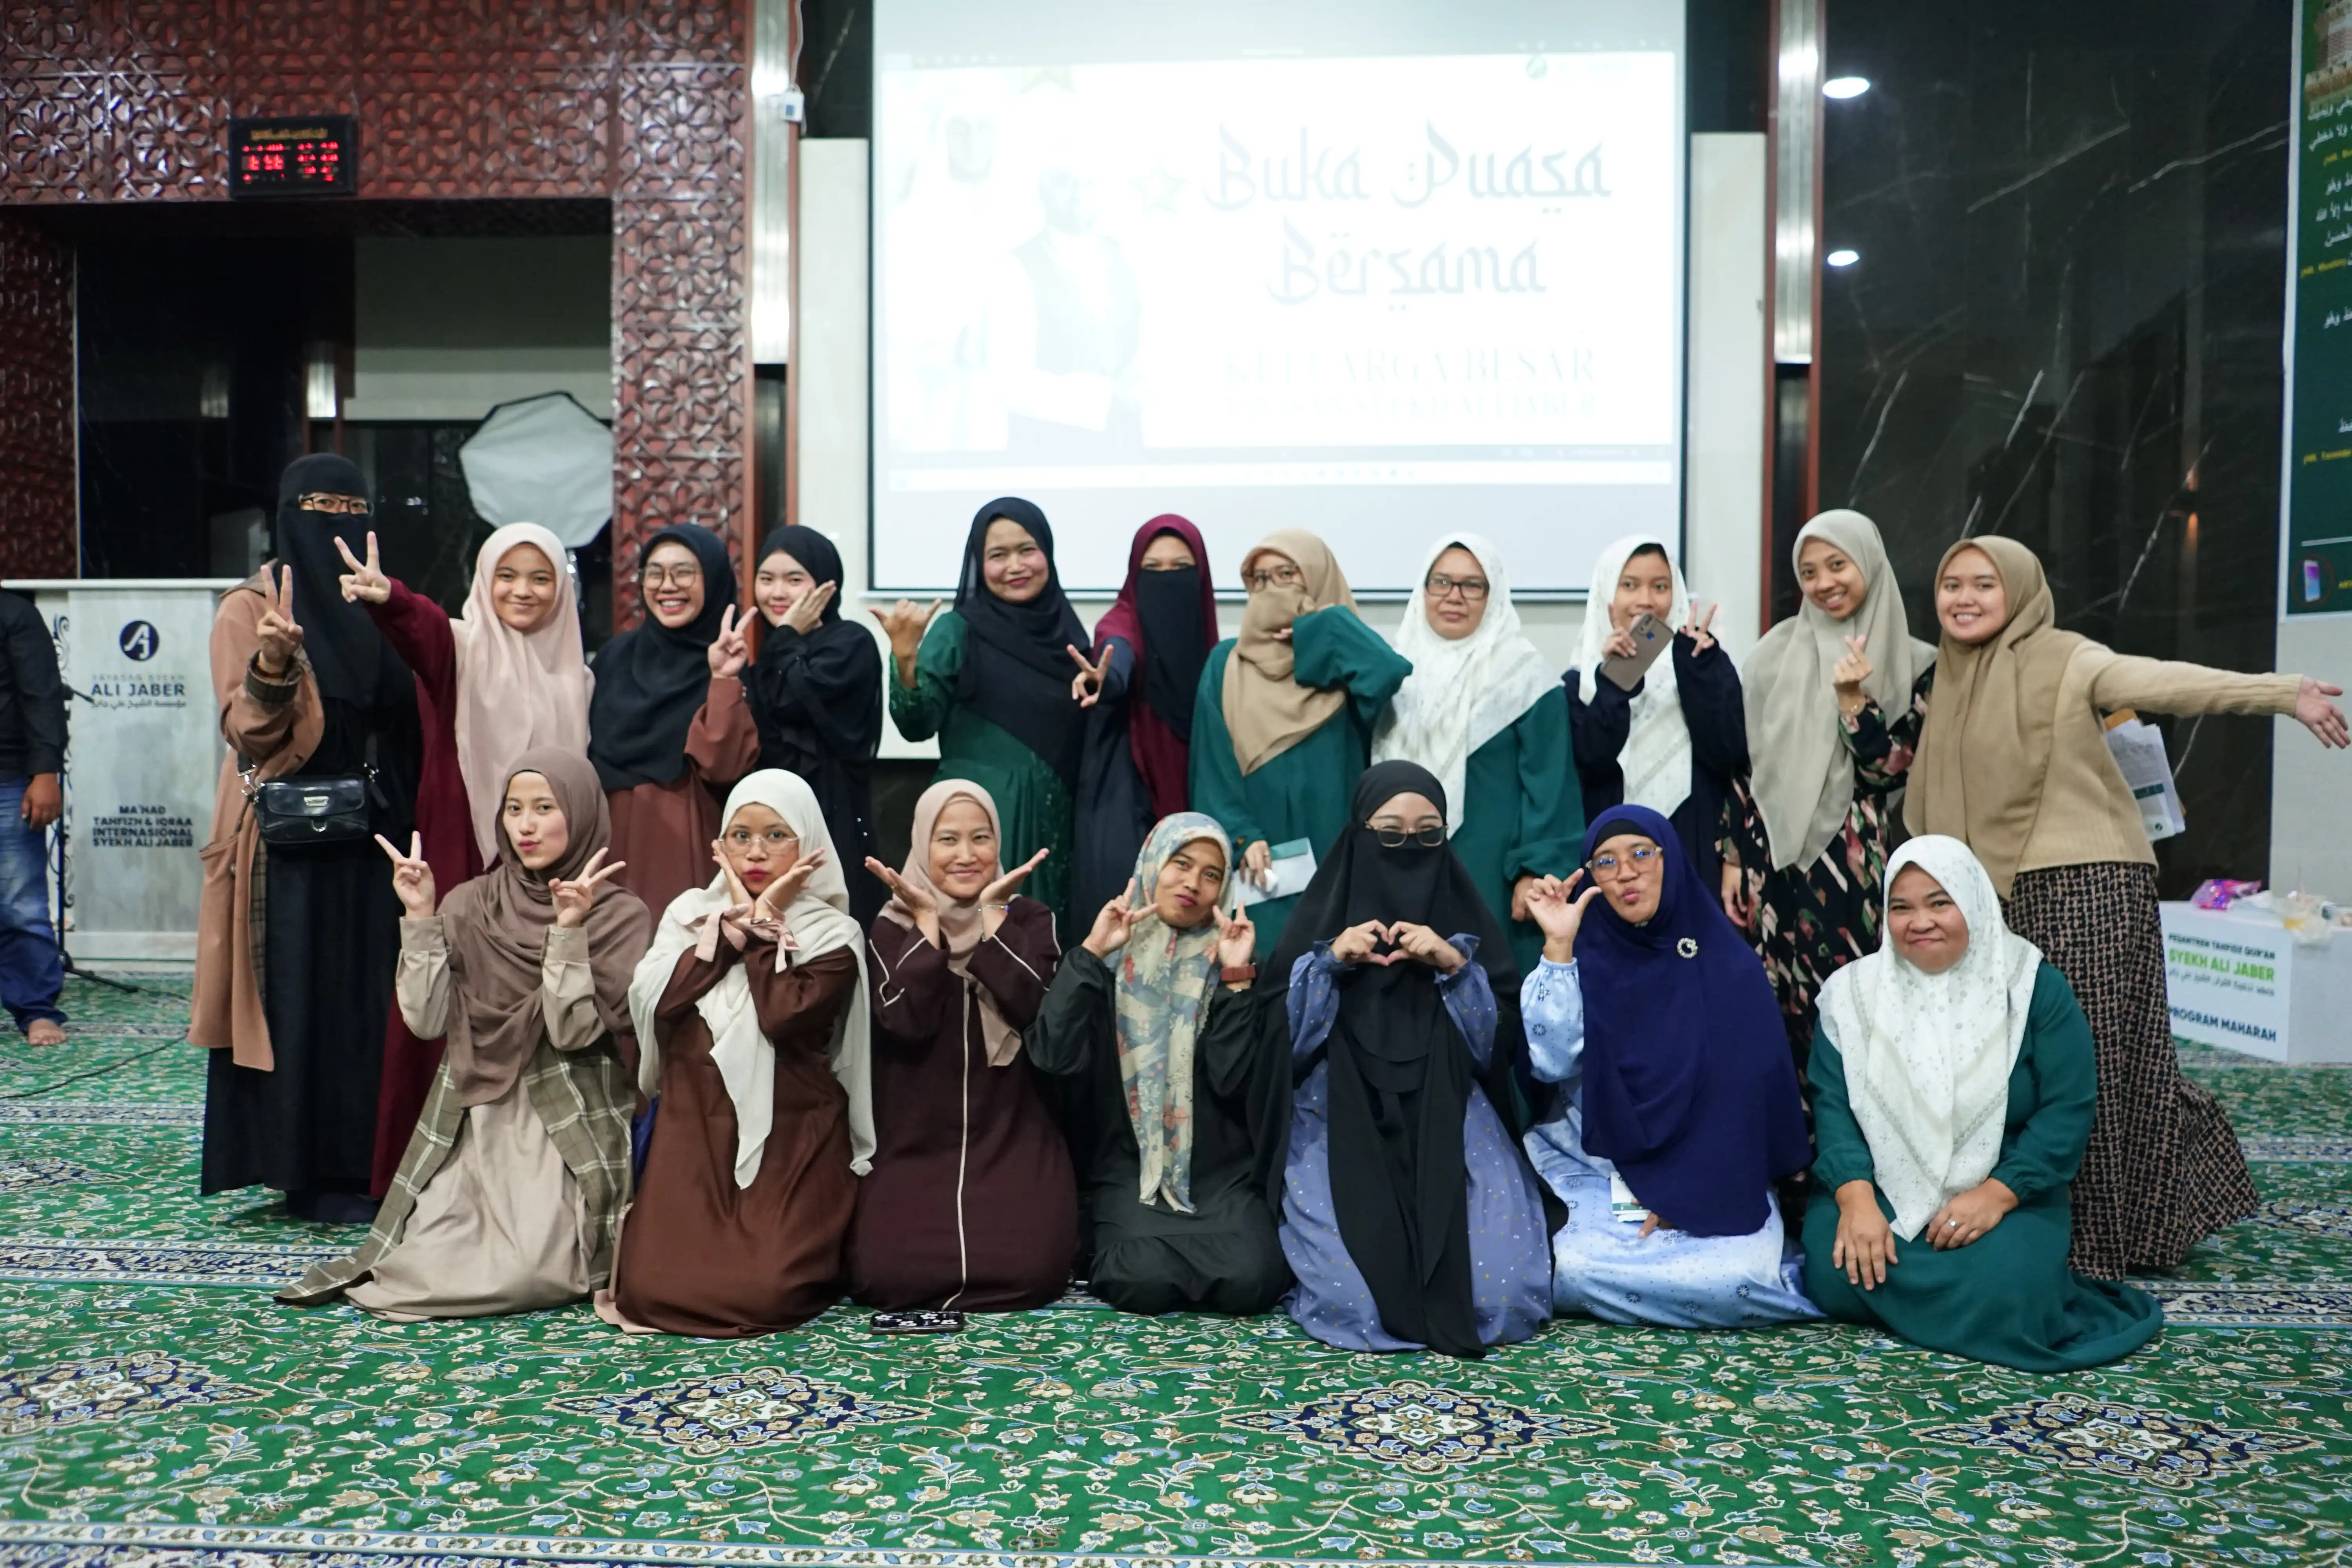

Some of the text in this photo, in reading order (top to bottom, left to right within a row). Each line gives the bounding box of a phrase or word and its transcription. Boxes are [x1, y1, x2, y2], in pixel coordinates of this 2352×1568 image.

[1202, 119, 1613, 214] Buka Puasa
[91, 683, 186, 697] ALI JABER
[92, 826, 192, 837] INTERNASIONAL
[93, 837, 192, 847] SYEKH ALI JABER
[2169, 948, 2275, 982] SYEKH ALI JABER
[2221, 1018, 2276, 1043] MAHARAH
